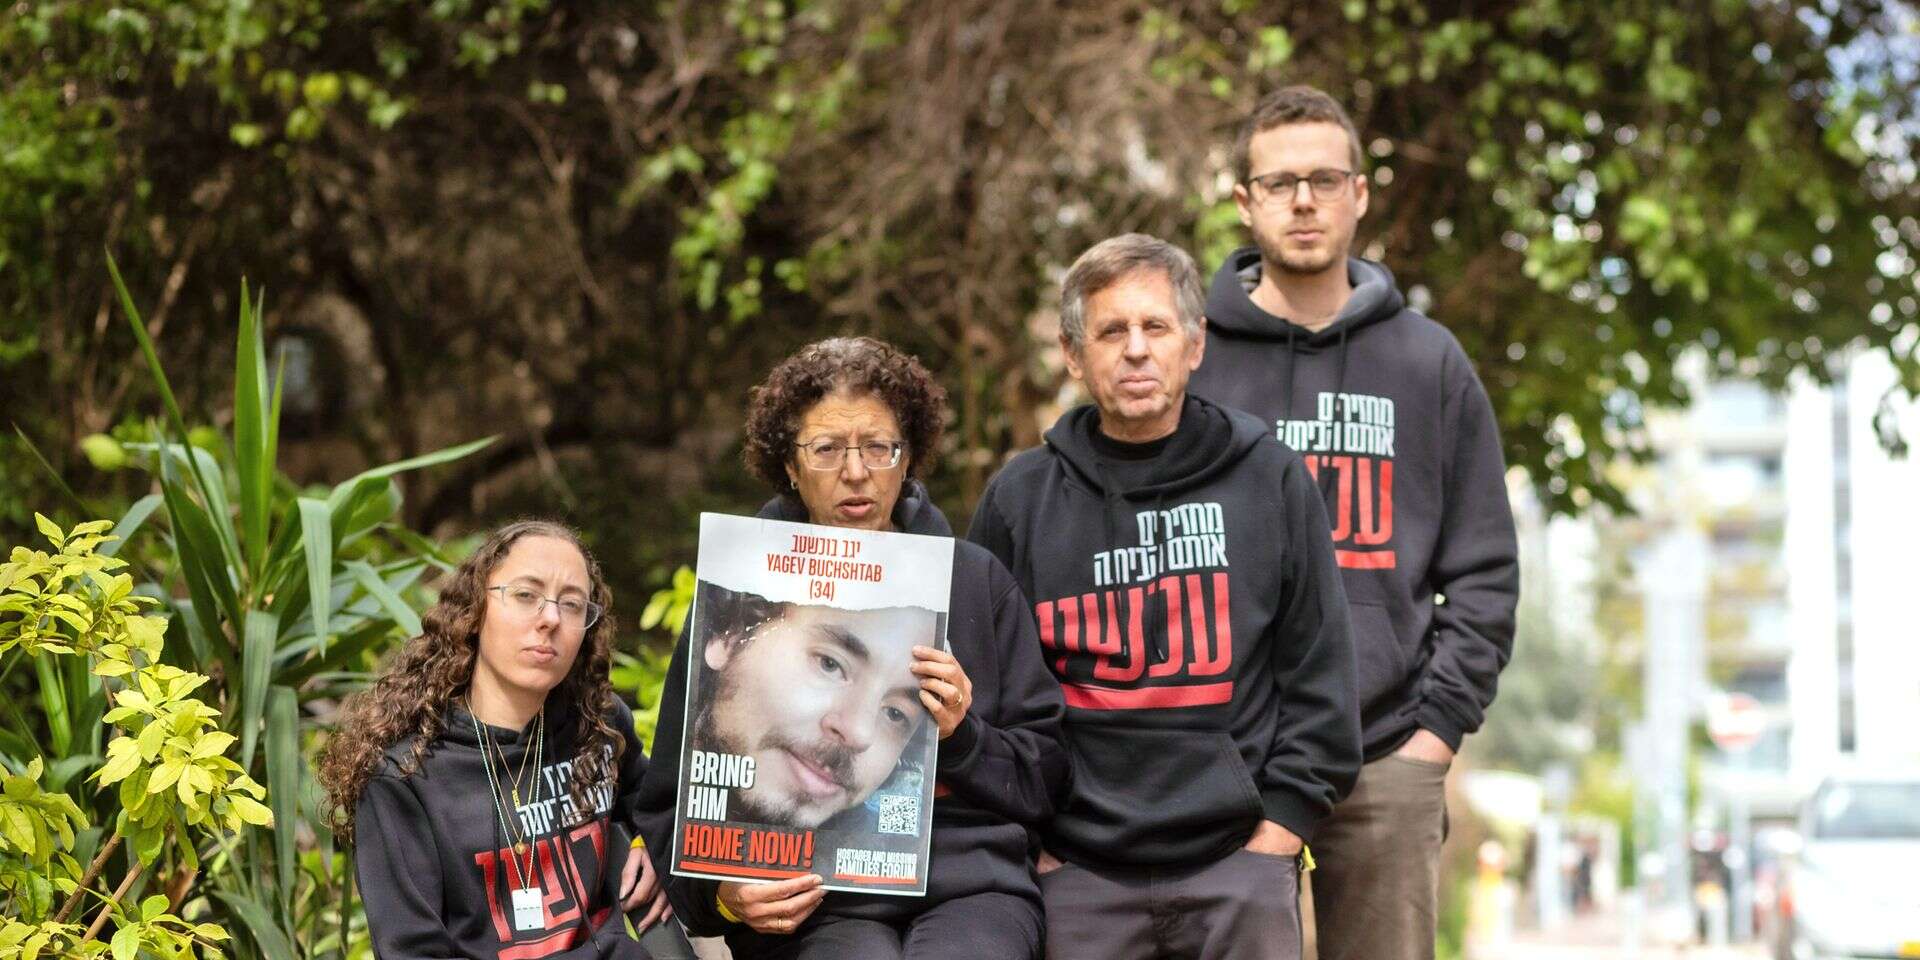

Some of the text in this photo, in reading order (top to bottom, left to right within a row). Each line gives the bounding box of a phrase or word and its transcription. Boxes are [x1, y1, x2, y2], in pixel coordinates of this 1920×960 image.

[1343, 422, 1396, 457] אותם
[1136, 502, 1225, 546] מחזירים
[791, 534, 861, 558] יגב בוכשטב
[1093, 533, 1229, 586] אותם הביתה
[767, 553, 882, 582] YAGEV BUCHSHTAB
[809, 579, 835, 601] (34)
[1035, 572, 1232, 682] עכשיו
[690, 750, 755, 789] BRING
[686, 785, 728, 822] HIM
[683, 823, 815, 868] HOME NOW!
[836, 847, 918, 866] HOSTAGES AND MISSING
[835, 859, 917, 880] FAMILIES FORUM
